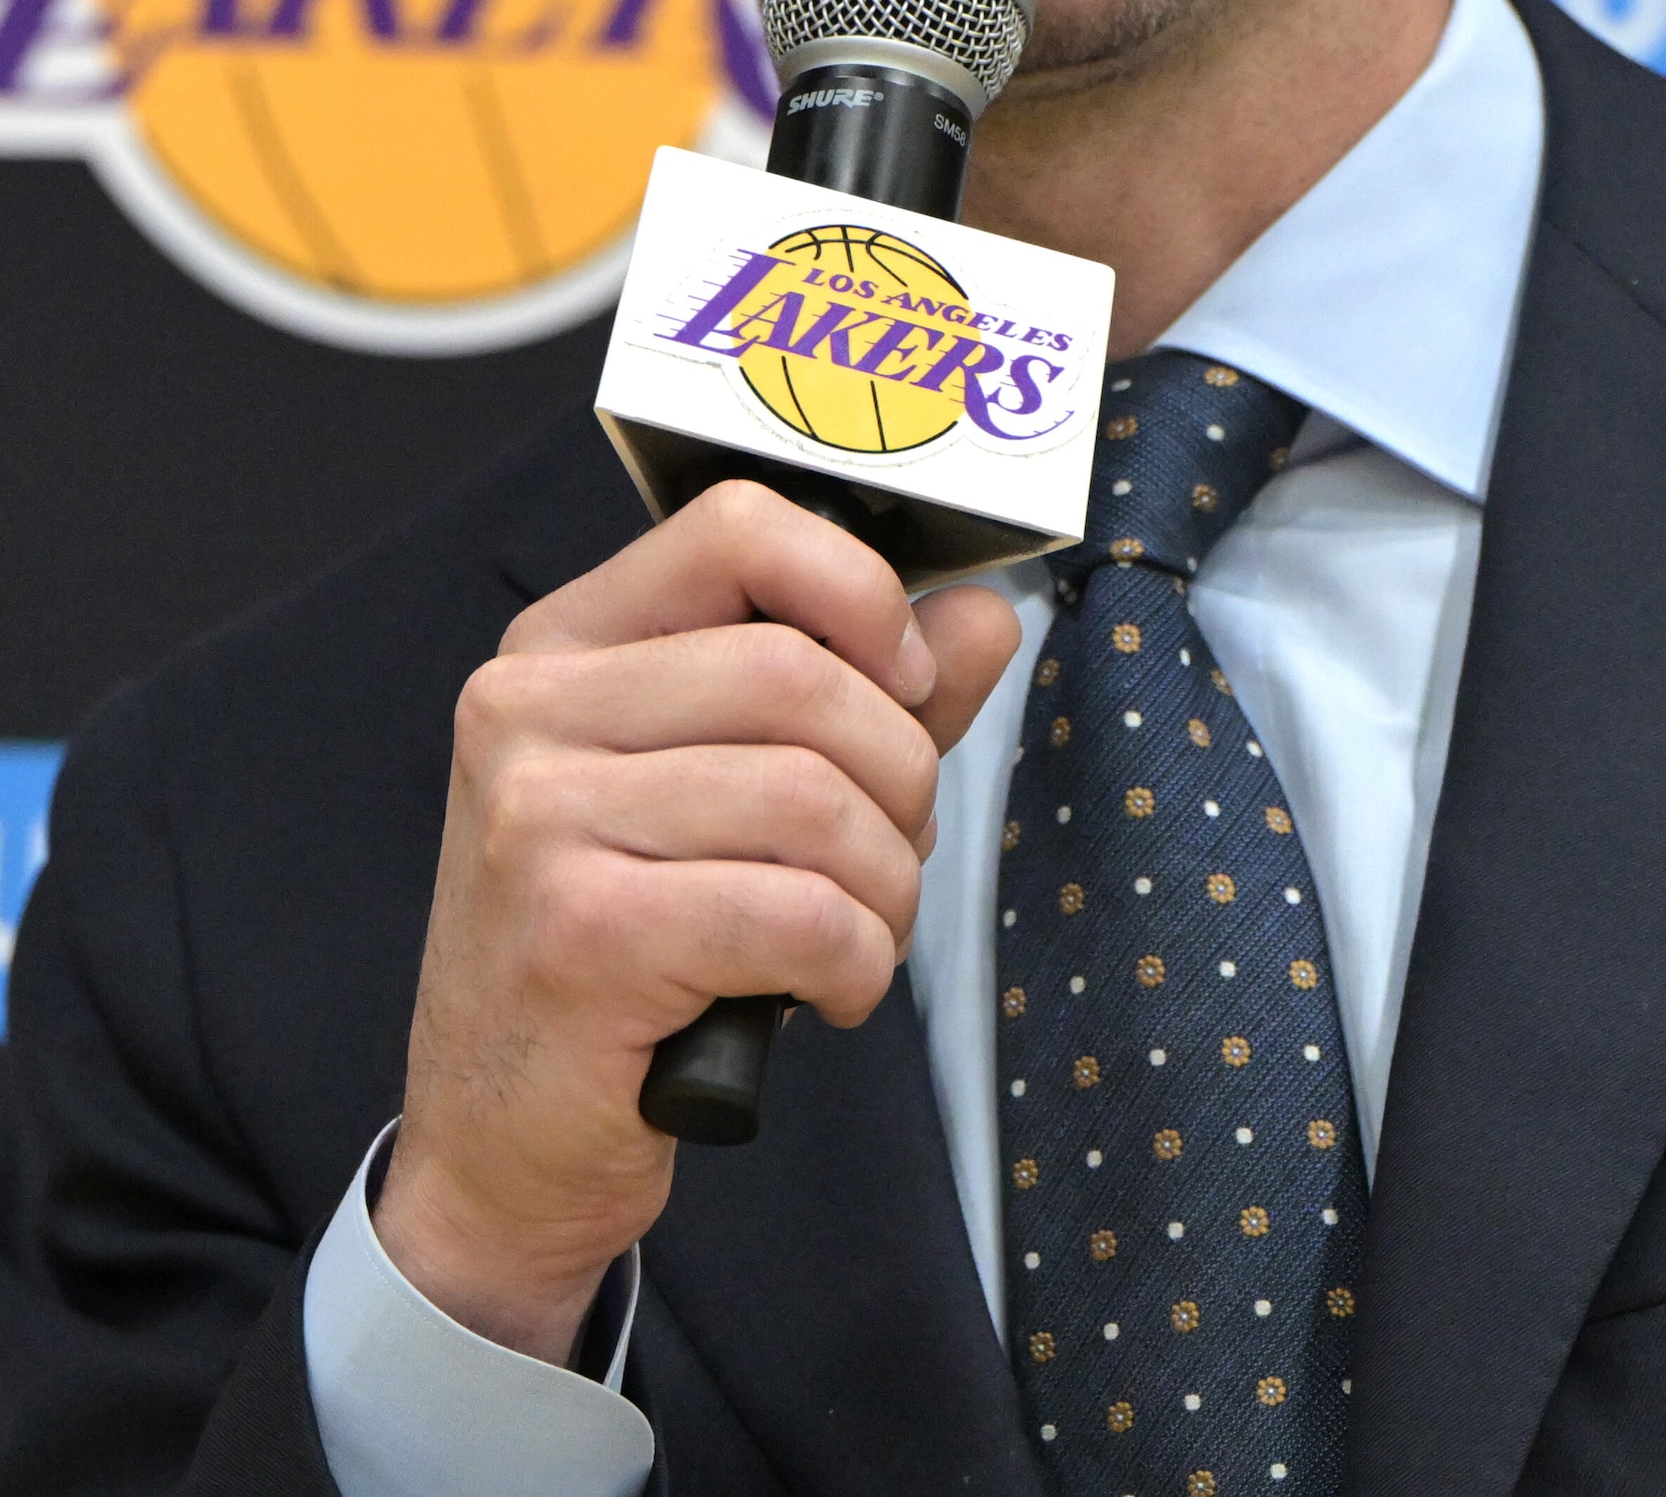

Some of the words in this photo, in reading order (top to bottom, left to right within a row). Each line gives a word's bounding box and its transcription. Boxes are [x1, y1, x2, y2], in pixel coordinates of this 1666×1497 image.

[933, 113, 968, 147] SM58
[654, 248, 1075, 441] LAKERS
[801, 267, 880, 300] LOS
[880, 291, 1073, 352] ANGELES
